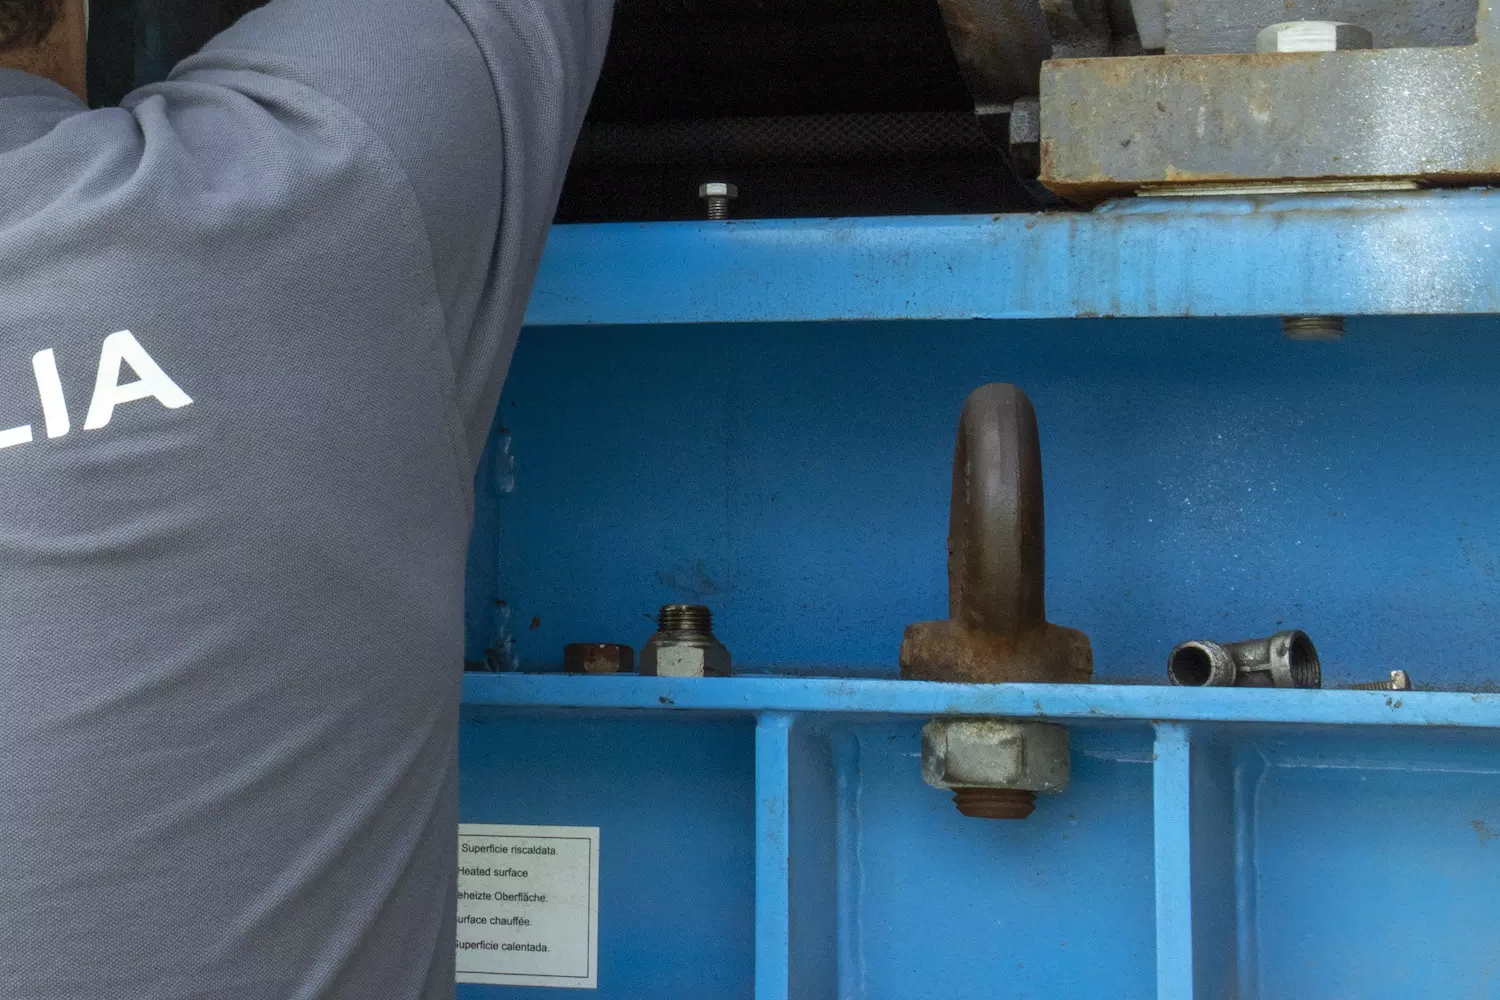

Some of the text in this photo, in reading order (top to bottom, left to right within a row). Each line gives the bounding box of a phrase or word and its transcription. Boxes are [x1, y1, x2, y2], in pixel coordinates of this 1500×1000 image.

[461, 843, 559, 856] Superficie riscaldata.
[457, 866, 528, 878] Heated surface
[457, 891, 548, 903] eheizte Oberfläche.
[455, 915, 533, 927] urface chauffée.
[501, 941, 550, 953] calentada.
